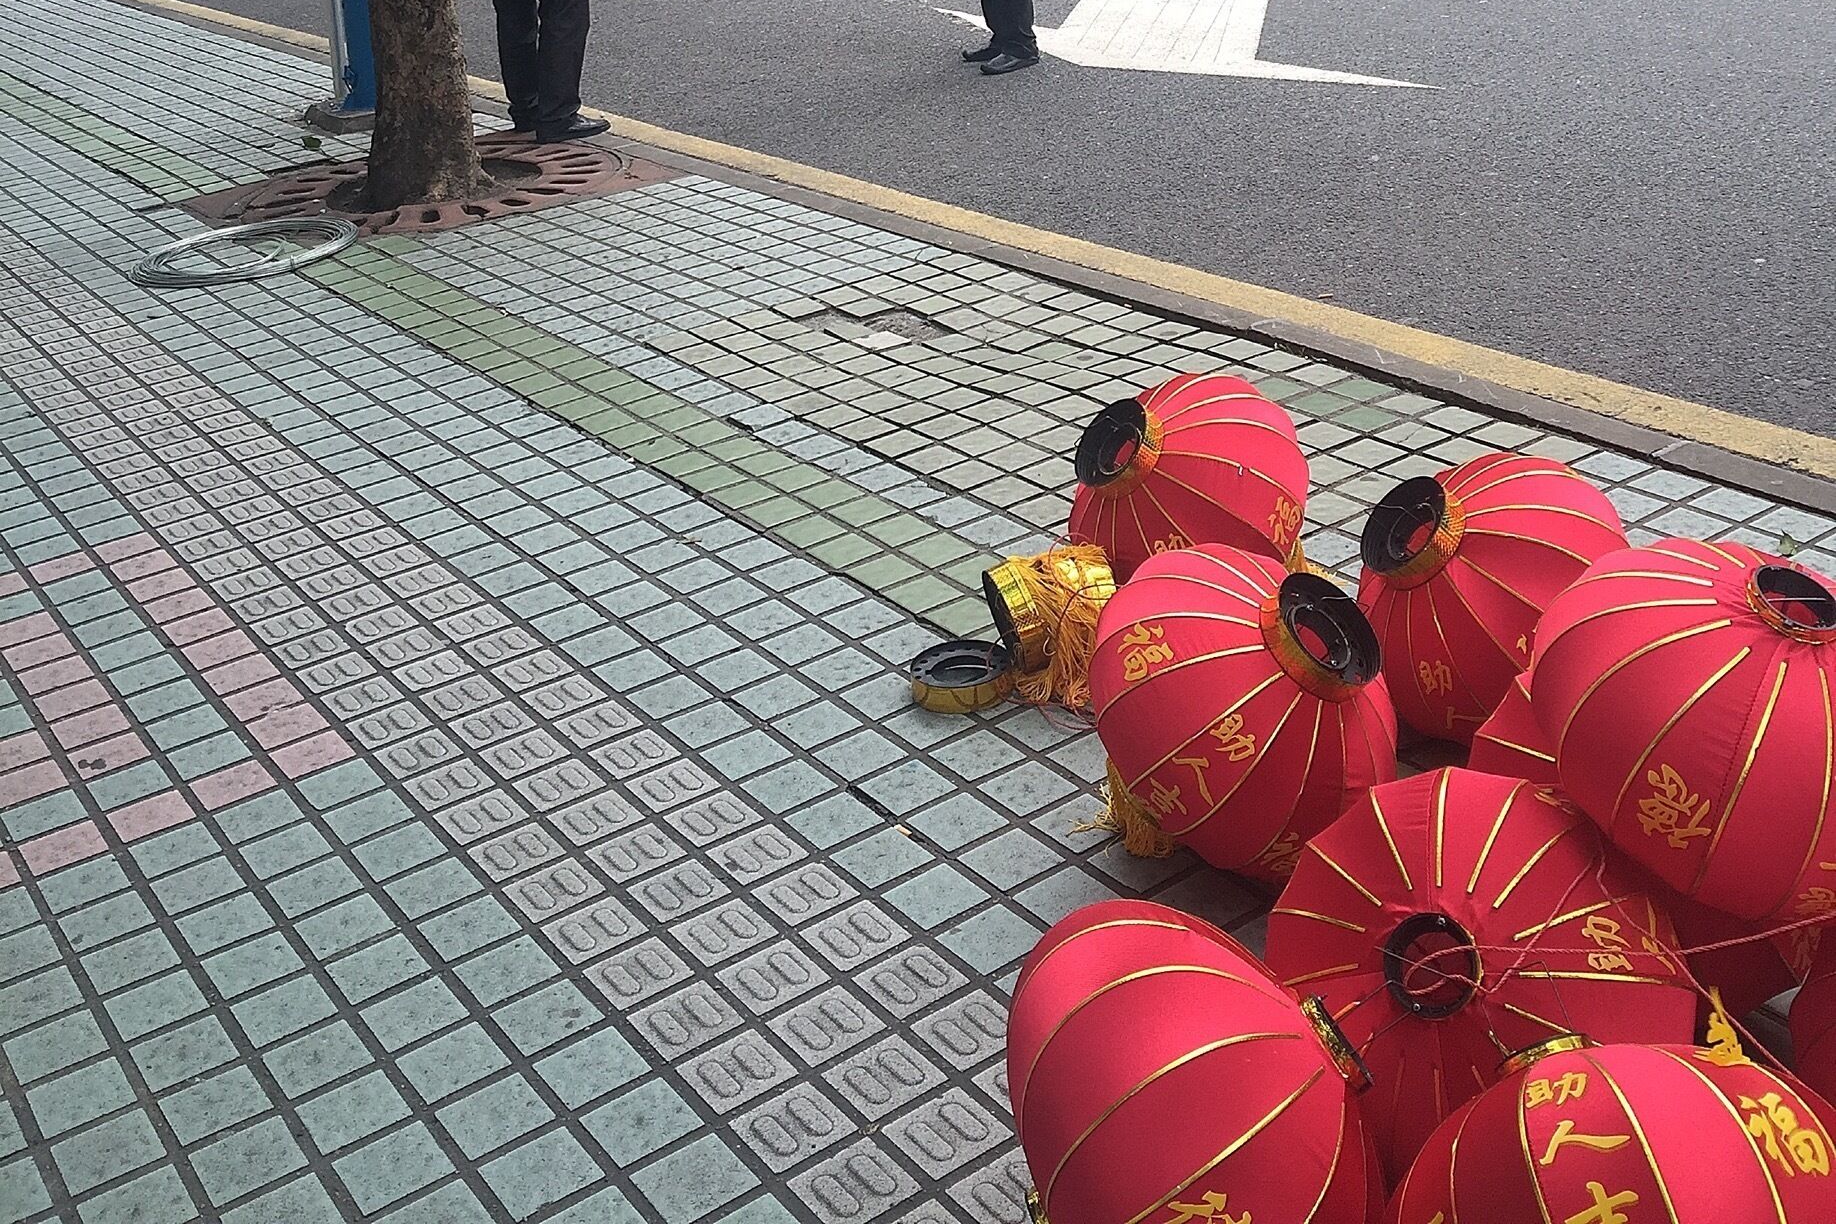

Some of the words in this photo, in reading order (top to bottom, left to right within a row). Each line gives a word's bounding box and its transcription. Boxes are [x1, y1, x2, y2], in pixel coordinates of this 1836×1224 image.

[1267, 496, 1305, 545] 福
[1117, 621, 1175, 682] 福
[1636, 763, 1712, 850] 德
[1737, 1092, 1830, 1179] 福
